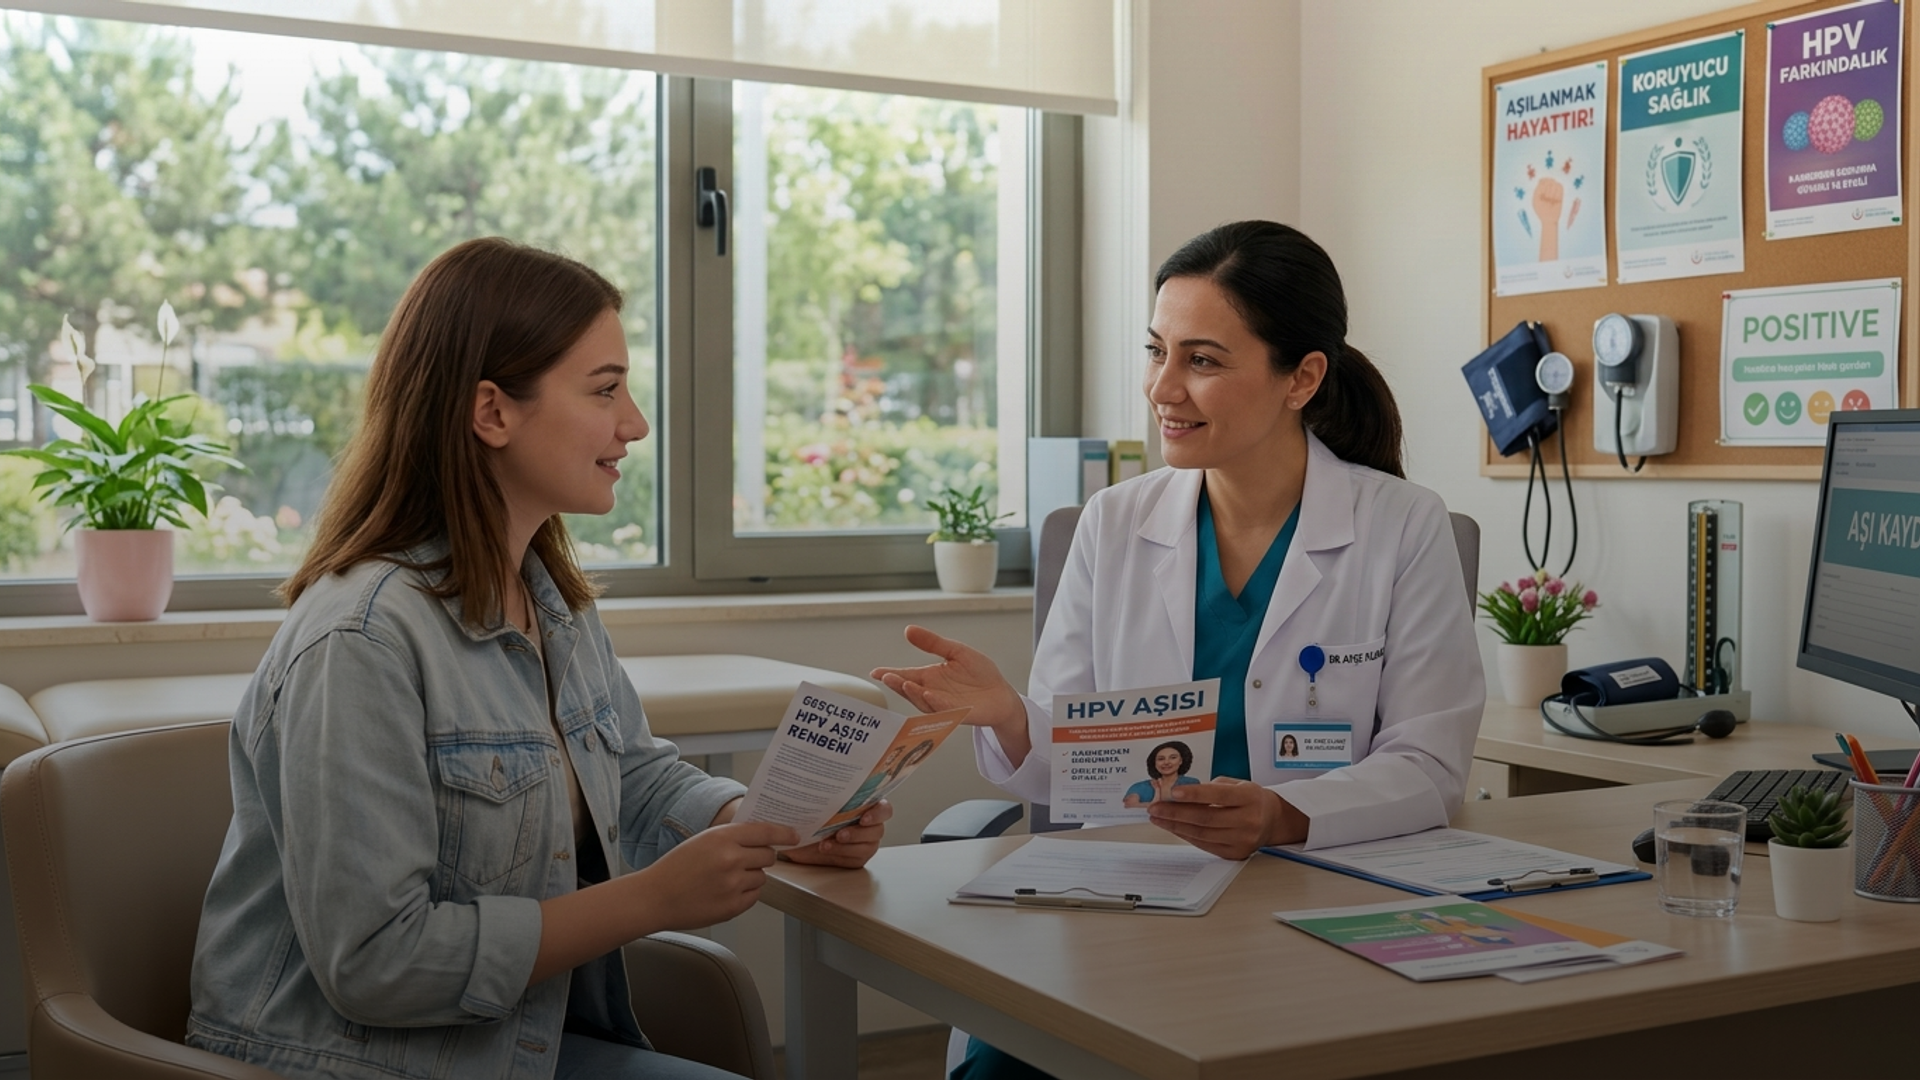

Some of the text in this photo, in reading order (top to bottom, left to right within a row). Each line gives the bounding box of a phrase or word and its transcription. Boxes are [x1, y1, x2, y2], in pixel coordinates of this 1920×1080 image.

[1803, 20, 1865, 59] HPV
[1632, 55, 1729, 93] KORUYUCU
[1780, 47, 1888, 84] FARKINDALIK
[1506, 82, 1596, 118] AŞILANMAK
[1647, 85, 1711, 115] SAĞLIK
[1507, 107, 1594, 141] HAYATTIR!
[1743, 308, 1879, 343] POSITIVE
[1847, 510, 1875, 551] AŞI
[795, 708, 828, 728] HPV
[1067, 690, 1204, 719] HPV AŞISI
